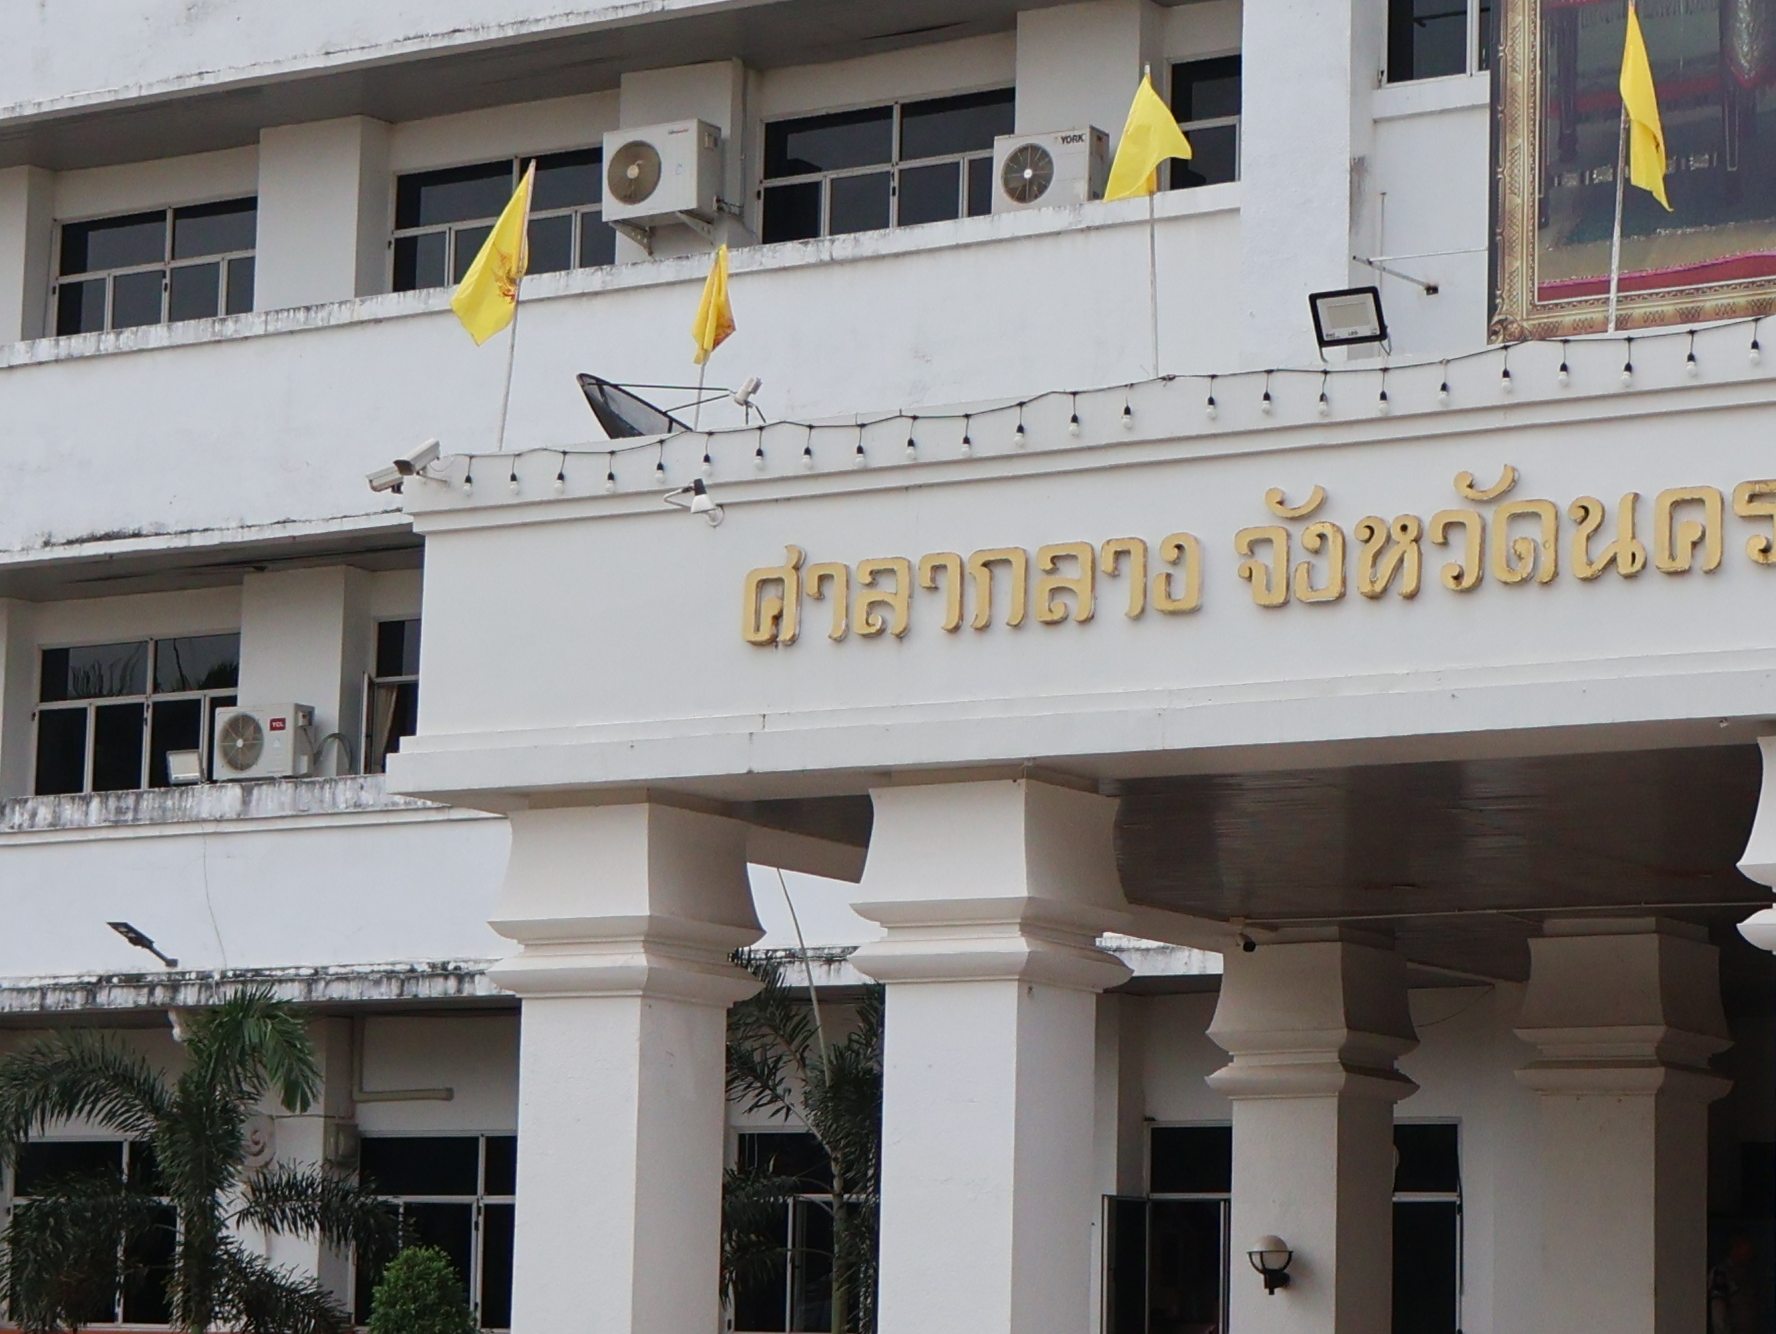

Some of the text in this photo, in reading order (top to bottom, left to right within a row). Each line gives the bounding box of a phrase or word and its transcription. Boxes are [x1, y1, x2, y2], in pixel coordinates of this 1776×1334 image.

[1060, 133, 1085, 145] YORK
[742, 532, 1202, 647] ศาลากลาง
